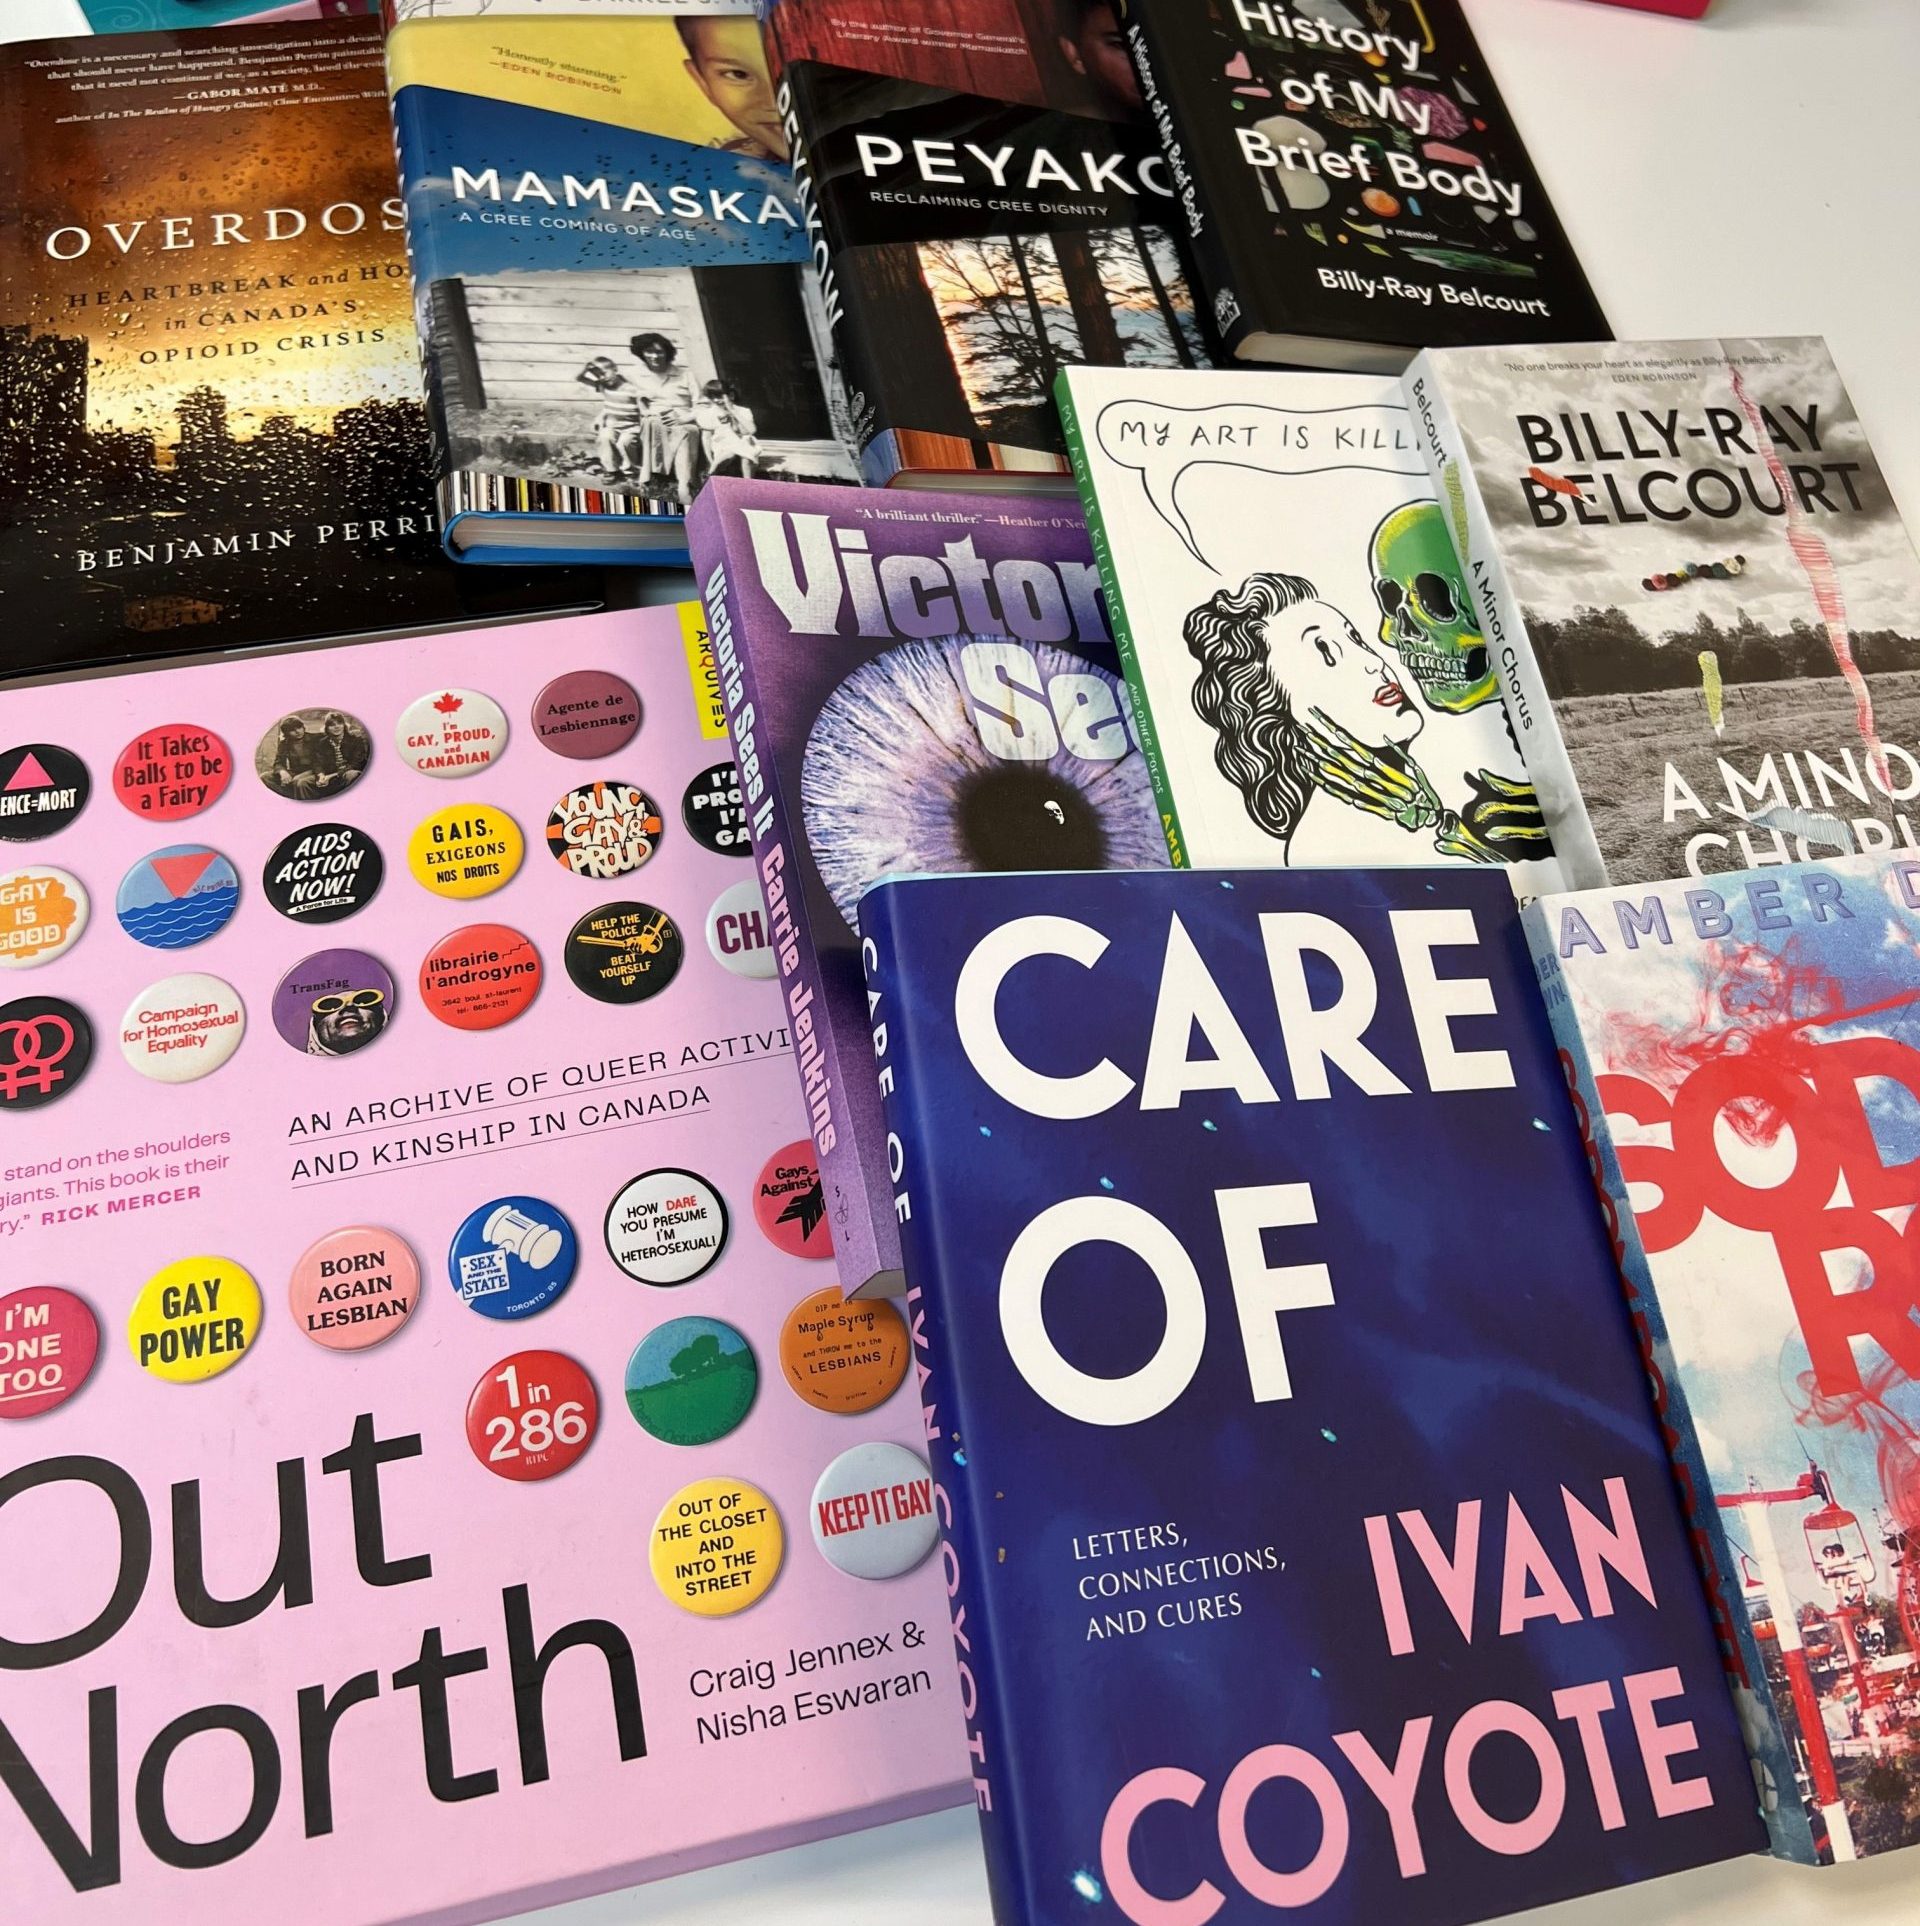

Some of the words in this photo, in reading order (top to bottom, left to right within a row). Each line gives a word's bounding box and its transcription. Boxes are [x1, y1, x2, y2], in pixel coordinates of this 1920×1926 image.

[1232, 0, 1421, 70] History
[545, 72, 622, 95] ROBINSON
[1280, 72, 1334, 109] of
[1348, 80, 1432, 136] My
[1235, 128, 1374, 182] Brief
[1387, 150, 1522, 217] Body
[451, 166, 799, 228] MAMASKA
[870, 190, 982, 210] RECLAIMING
[988, 199, 1034, 214] CREE
[1039, 203, 1109, 218] DIGNITY
[480, 212, 533, 228] CREE
[543, 217, 618, 235] COMING
[625, 224, 652, 237] OF
[658, 228, 697, 242] AGE
[69, 273, 296, 309] HEARTBREAK
[308, 269, 350, 287] and
[1317, 267, 1434, 308] Billy-Ray
[1439, 283, 1551, 318] Belcourt
[165, 315, 187, 332] in
[198, 298, 358, 330] CANADA'S
[139, 340, 260, 366] OPIOID
[276, 328, 386, 353] CRISIS
[1549, 361, 1580, 370] breaks
[1604, 360, 1630, 369] heart
[1612, 374, 1640, 383] EDEN
[1643, 372, 1697, 382] ROBINSON
[1190, 424, 1259, 448] ART
[1283, 424, 1309, 450] IS
[1411, 378, 1447, 467] Belcourt
[1515, 403, 1826, 464] BILLY-RAY
[1518, 462, 1867, 529] BELCOURT
[876, 509, 930, 523] brilliant
[78, 528, 296, 573] BENJAMIN
[318, 512, 435, 545] PERRI
[1070, 447, 1088, 484] ART
[1084, 496, 1096, 517] IS
[1091, 529, 1121, 621] KILLING
[1117, 632, 1132, 665] ME
[1476, 579, 1507, 645] Minor
[1501, 648, 1534, 731] Chorus
[705, 561, 745, 713] Victoria
[734, 702, 765, 803] Sees
[547, 697, 600, 717] Agente
[604, 693, 625, 707] de
[960, 642, 1142, 761] Se
[539, 710, 637, 738] Lesbiennage
[138, 739, 153, 761] It
[160, 733, 210, 758] Takes
[417, 750, 491, 770] CANADIAN
[123, 763, 167, 788] Balls
[174, 759, 195, 780] to
[200, 754, 223, 776] be
[158, 784, 209, 810] Fairy
[1663, 762, 1712, 822] A
[294, 831, 352, 858] AIDS
[432, 818, 494, 845] GAIS,
[275, 849, 365, 884] ACTION
[426, 841, 506, 866] EXIGEONS
[566, 837, 653, 878] PROUD
[289, 873, 356, 903] NOW!
[437, 868, 458, 884] NOS
[464, 862, 500, 881] DROITS
[15, 905, 37, 925] IS
[591, 916, 618, 931] HELP
[620, 913, 641, 927] THE
[601, 924, 639, 940] POLICE
[1559, 871, 1855, 959] AMBER
[425, 958, 536, 991] l'androgyne
[429, 949, 499, 973] librairie
[600, 961, 652, 978] YOURSELF
[289, 978, 350, 996] TransFag
[759, 843, 800, 977] Carrie
[788, 979, 838, 1157] Jenkins
[123, 1026, 145, 1043] for
[147, 1010, 239, 1038] Homosexual
[138, 1000, 218, 1026] Campaign
[955, 909, 1516, 1121] CARE
[147, 1033, 208, 1055] Equality
[288, 1111, 333, 1138] AN
[346, 1080, 495, 1127] ARCHIVE
[507, 1071, 549, 1097] OF
[562, 1050, 667, 1088] QUEER
[680, 1027, 792, 1067] ACTIVI
[291, 1148, 360, 1181] AND
[372, 1121, 515, 1166] KINSHIP
[529, 1110, 566, 1137] IN
[578, 1085, 711, 1127] CANADA
[4, 1157, 62, 1182] stand
[67, 1155, 93, 1171] on
[96, 1145, 130, 1166] the
[134, 1129, 231, 1160] shoulders
[64, 1174, 106, 1197] This
[109, 1165, 160, 1190] book
[164, 1162, 181, 1180] is
[184, 1153, 230, 1176] their
[760, 1174, 814, 1197] Against
[41, 1202, 99, 1227] RICK
[107, 1185, 202, 1214] MERCER
[619, 1217, 650, 1234] YOU
[653, 1207, 708, 1229] PRESUME
[627, 1202, 658, 1219] HOW
[666, 1195, 698, 1212] DARE
[319, 1250, 386, 1279] BORN
[470, 1254, 497, 1272] SEX
[620, 1235, 717, 1264] HETEROSEXUAL!
[162, 1278, 222, 1320] GAY
[317, 1274, 393, 1304] AGAIN
[464, 1274, 507, 1295] STATE
[5, 1302, 50, 1332] I'M
[307, 1297, 409, 1332] LESBIAN
[506, 1292, 546, 1313] TORONTO
[999, 1182, 1336, 1427] OF
[140, 1316, 246, 1367] POWER
[798, 1318, 835, 1341] Maple
[838, 1312, 874, 1332] Syrup
[809, 1351, 882, 1375] LESBIANS
[496, 1365, 521, 1409] 1
[528, 1382, 551, 1404] in
[485, 1401, 588, 1463] 286
[678, 1498, 712, 1518] OUT
[719, 1493, 742, 1508] OF
[818, 1492, 871, 1538] KEEP
[0, 1412, 432, 1671] Out
[659, 1523, 693, 1543] THE
[699, 1508, 767, 1535] CLOSET
[1072, 1521, 1189, 1562] LETTERS,
[698, 1535, 735, 1555] AND
[675, 1560, 716, 1580] INTO
[722, 1550, 757, 1569] THE
[1078, 1546, 1288, 1601] CONNECTIONS,
[1363, 1476, 1658, 1657] IVAN
[685, 1570, 753, 1597] STREET
[1086, 1609, 1148, 1642] AND
[1157, 1592, 1243, 1629] CURES
[689, 1656, 776, 1698] Craig
[785, 1630, 894, 1678] Jennex
[901, 1621, 926, 1648] &
[696, 1701, 788, 1745] Nisha
[794, 1669, 932, 1722] Eswaran
[0, 1583, 648, 1893] North
[1100, 1666, 1714, 1926] COYOTE
